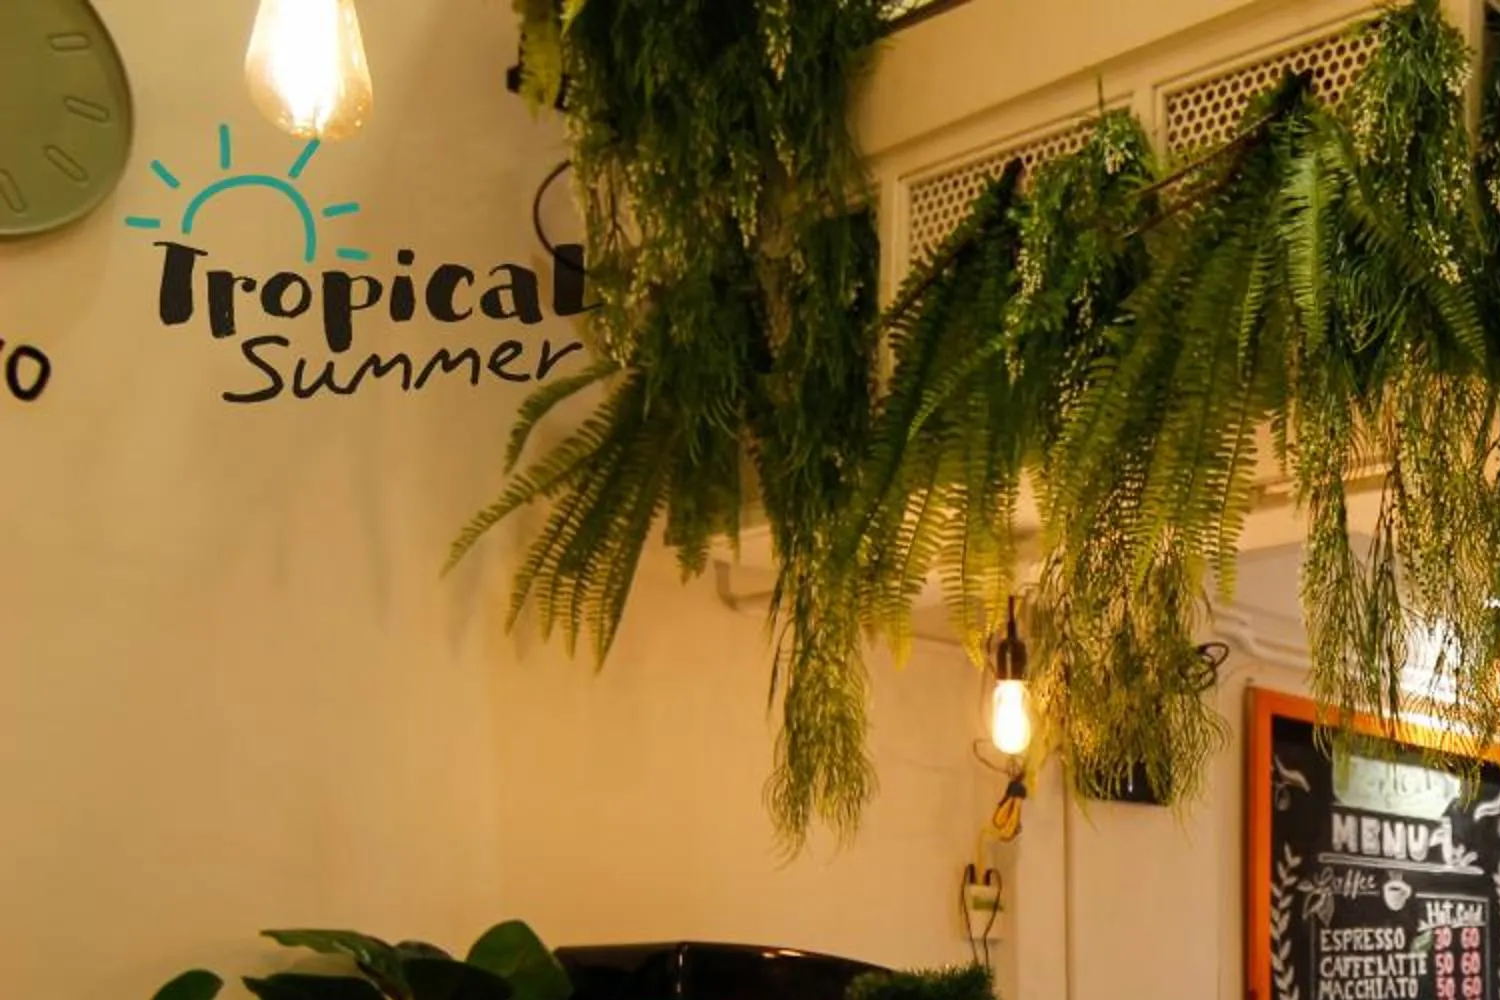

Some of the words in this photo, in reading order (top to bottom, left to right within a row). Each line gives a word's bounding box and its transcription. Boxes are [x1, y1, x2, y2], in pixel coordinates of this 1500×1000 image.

[153, 241, 603, 353] Tropical
[222, 335, 583, 402] Summer
[1332, 812, 1430, 862] MENU
[1320, 927, 1405, 950] ESPRESSO
[1435, 952, 1454, 975] 50
[1461, 951, 1481, 975] 60
[1318, 977, 1419, 1000] MACCHIATO
[1436, 976, 1456, 998] 50
